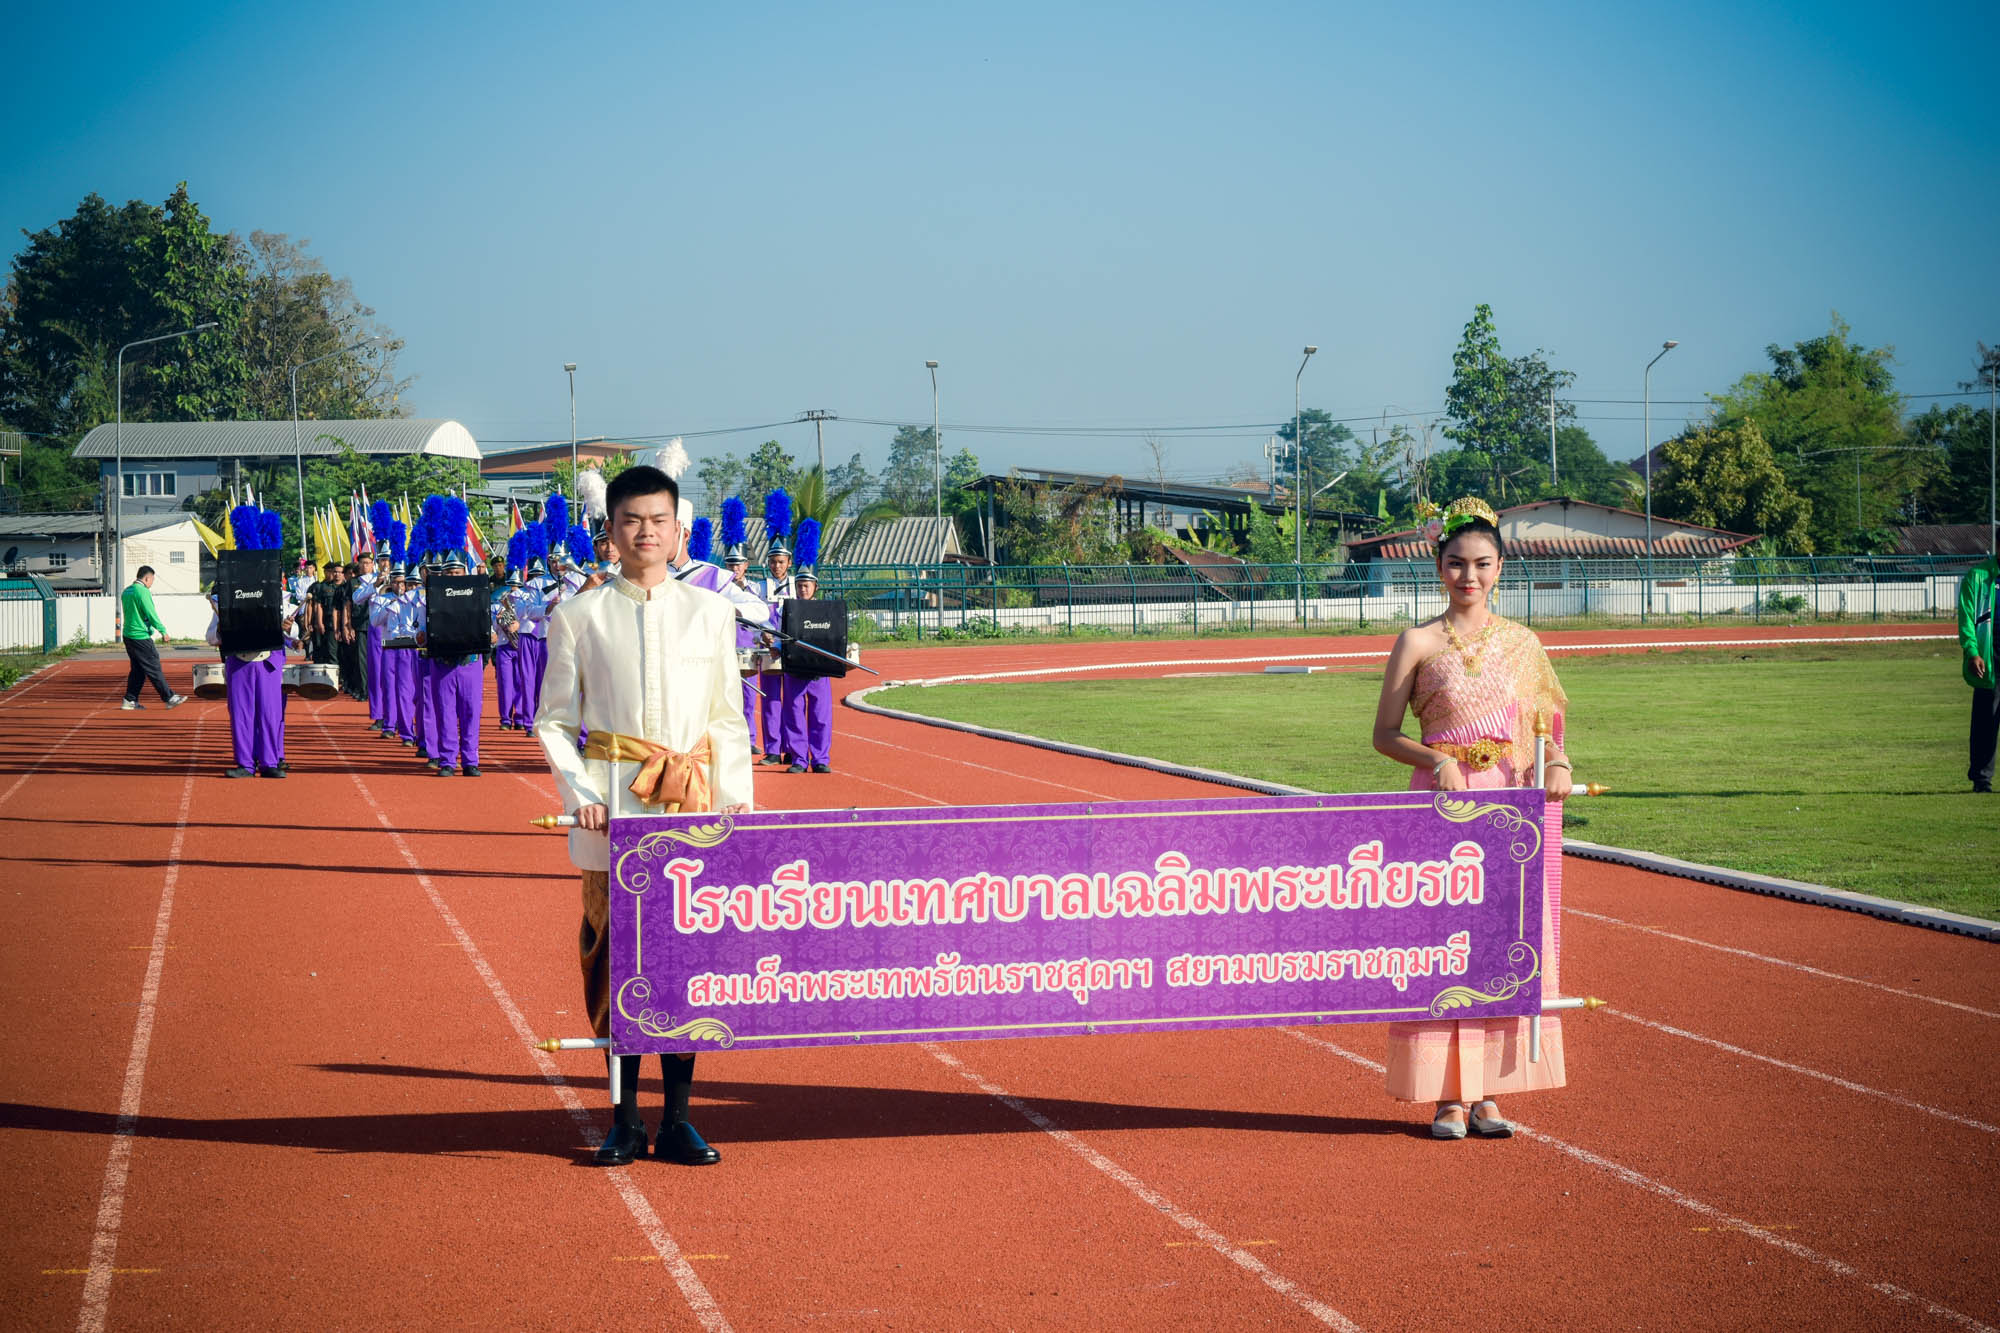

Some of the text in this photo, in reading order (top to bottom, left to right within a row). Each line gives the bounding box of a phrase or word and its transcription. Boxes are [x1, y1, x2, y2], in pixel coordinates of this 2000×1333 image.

[234, 589, 263, 599] Dynasty
[664, 841, 1484, 933] โรงเรียนเทศบาลเฉลิมพระเกียรติ
[688, 931, 1470, 1004] สมเด็จพระเทพรัตนราชสุดาฯ สยามบรมราชกุมารี
